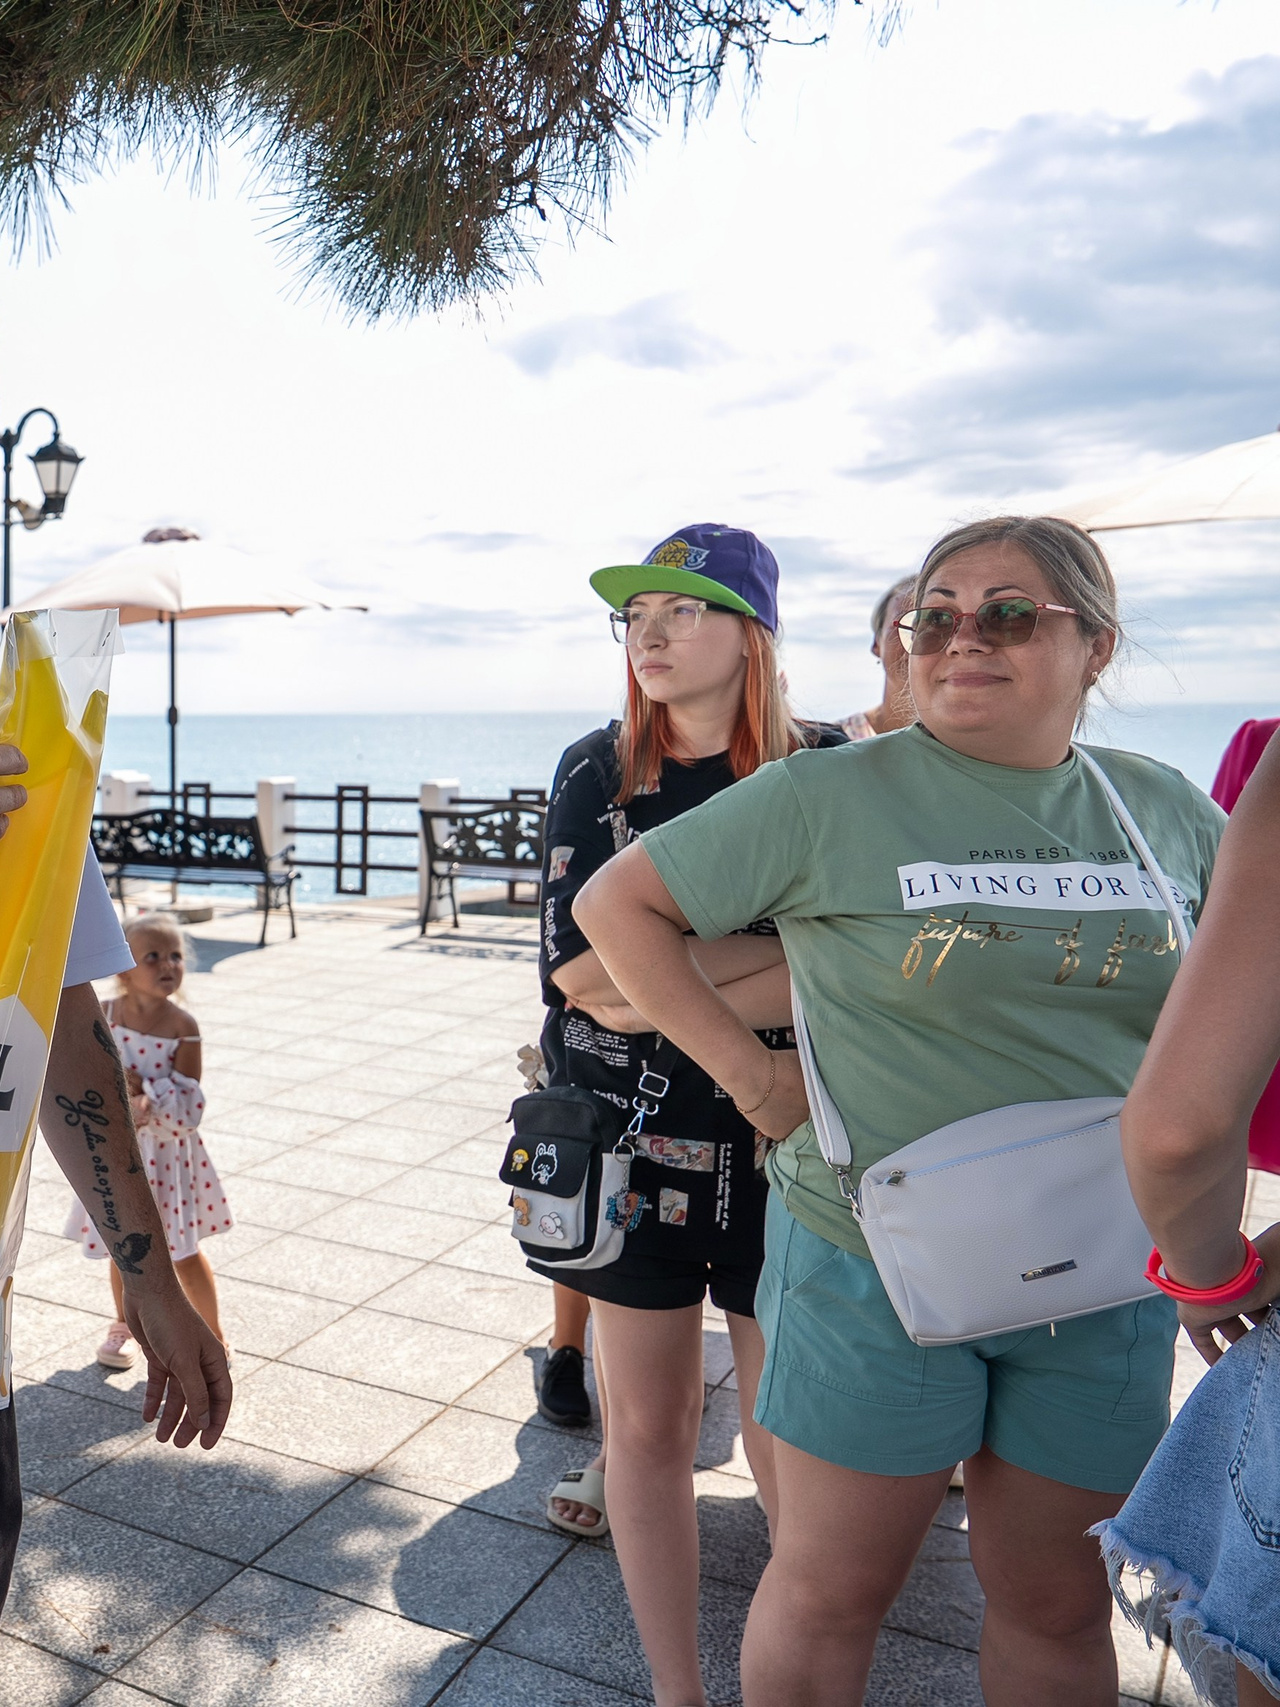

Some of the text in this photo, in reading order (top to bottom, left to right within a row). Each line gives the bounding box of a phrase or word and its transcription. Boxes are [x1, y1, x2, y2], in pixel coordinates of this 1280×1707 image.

[969, 849, 1026, 860] PARIS
[1089, 849, 1129, 862] 1988
[904, 872, 1038, 899] LIVING
[1054, 874, 1130, 898] FOR
[901, 910, 1024, 988] future
